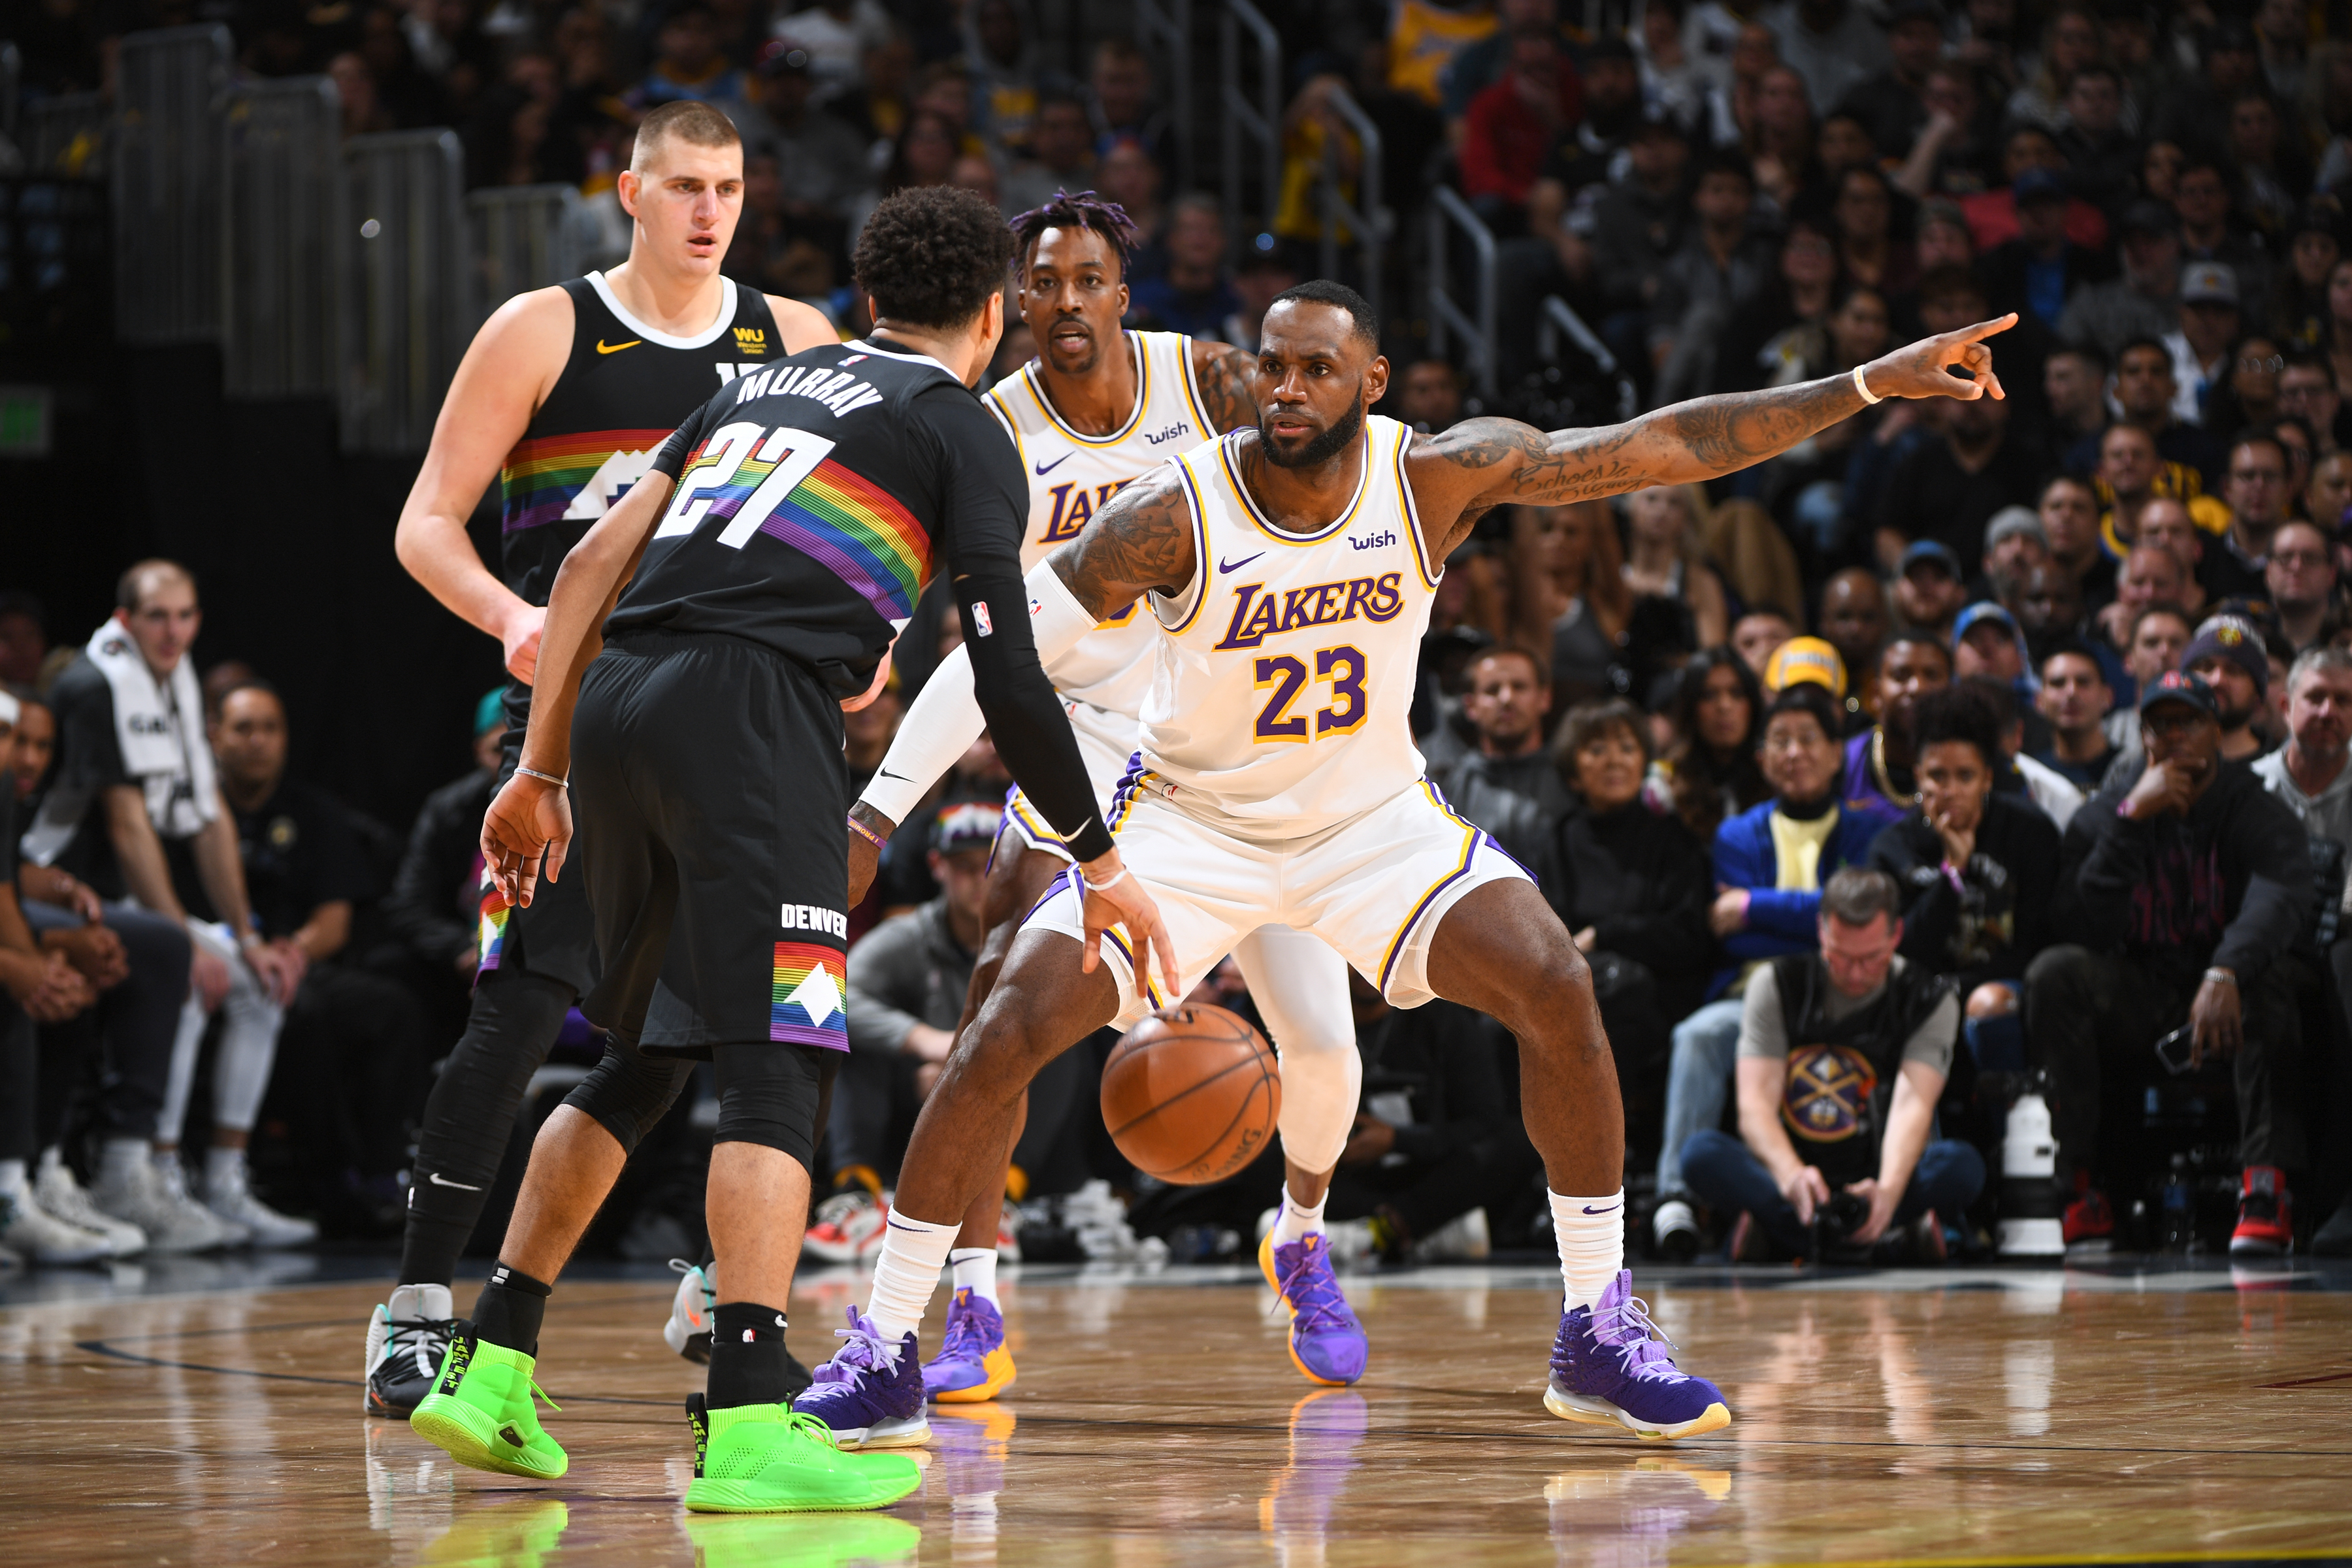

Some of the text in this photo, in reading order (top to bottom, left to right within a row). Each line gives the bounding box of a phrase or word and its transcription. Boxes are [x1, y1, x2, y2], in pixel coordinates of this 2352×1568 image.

[732, 327, 764, 342] WU
[736, 367, 883, 418] MURRAY
[1145, 421, 1188, 444] wish
[653, 421, 836, 549] 27
[1348, 530, 1396, 551] wish
[1211, 571, 1405, 652] LAKERS
[1252, 644, 1368, 744] 23
[849, 820, 875, 841] PROMISE
[781, 904, 847, 941] DENVER
